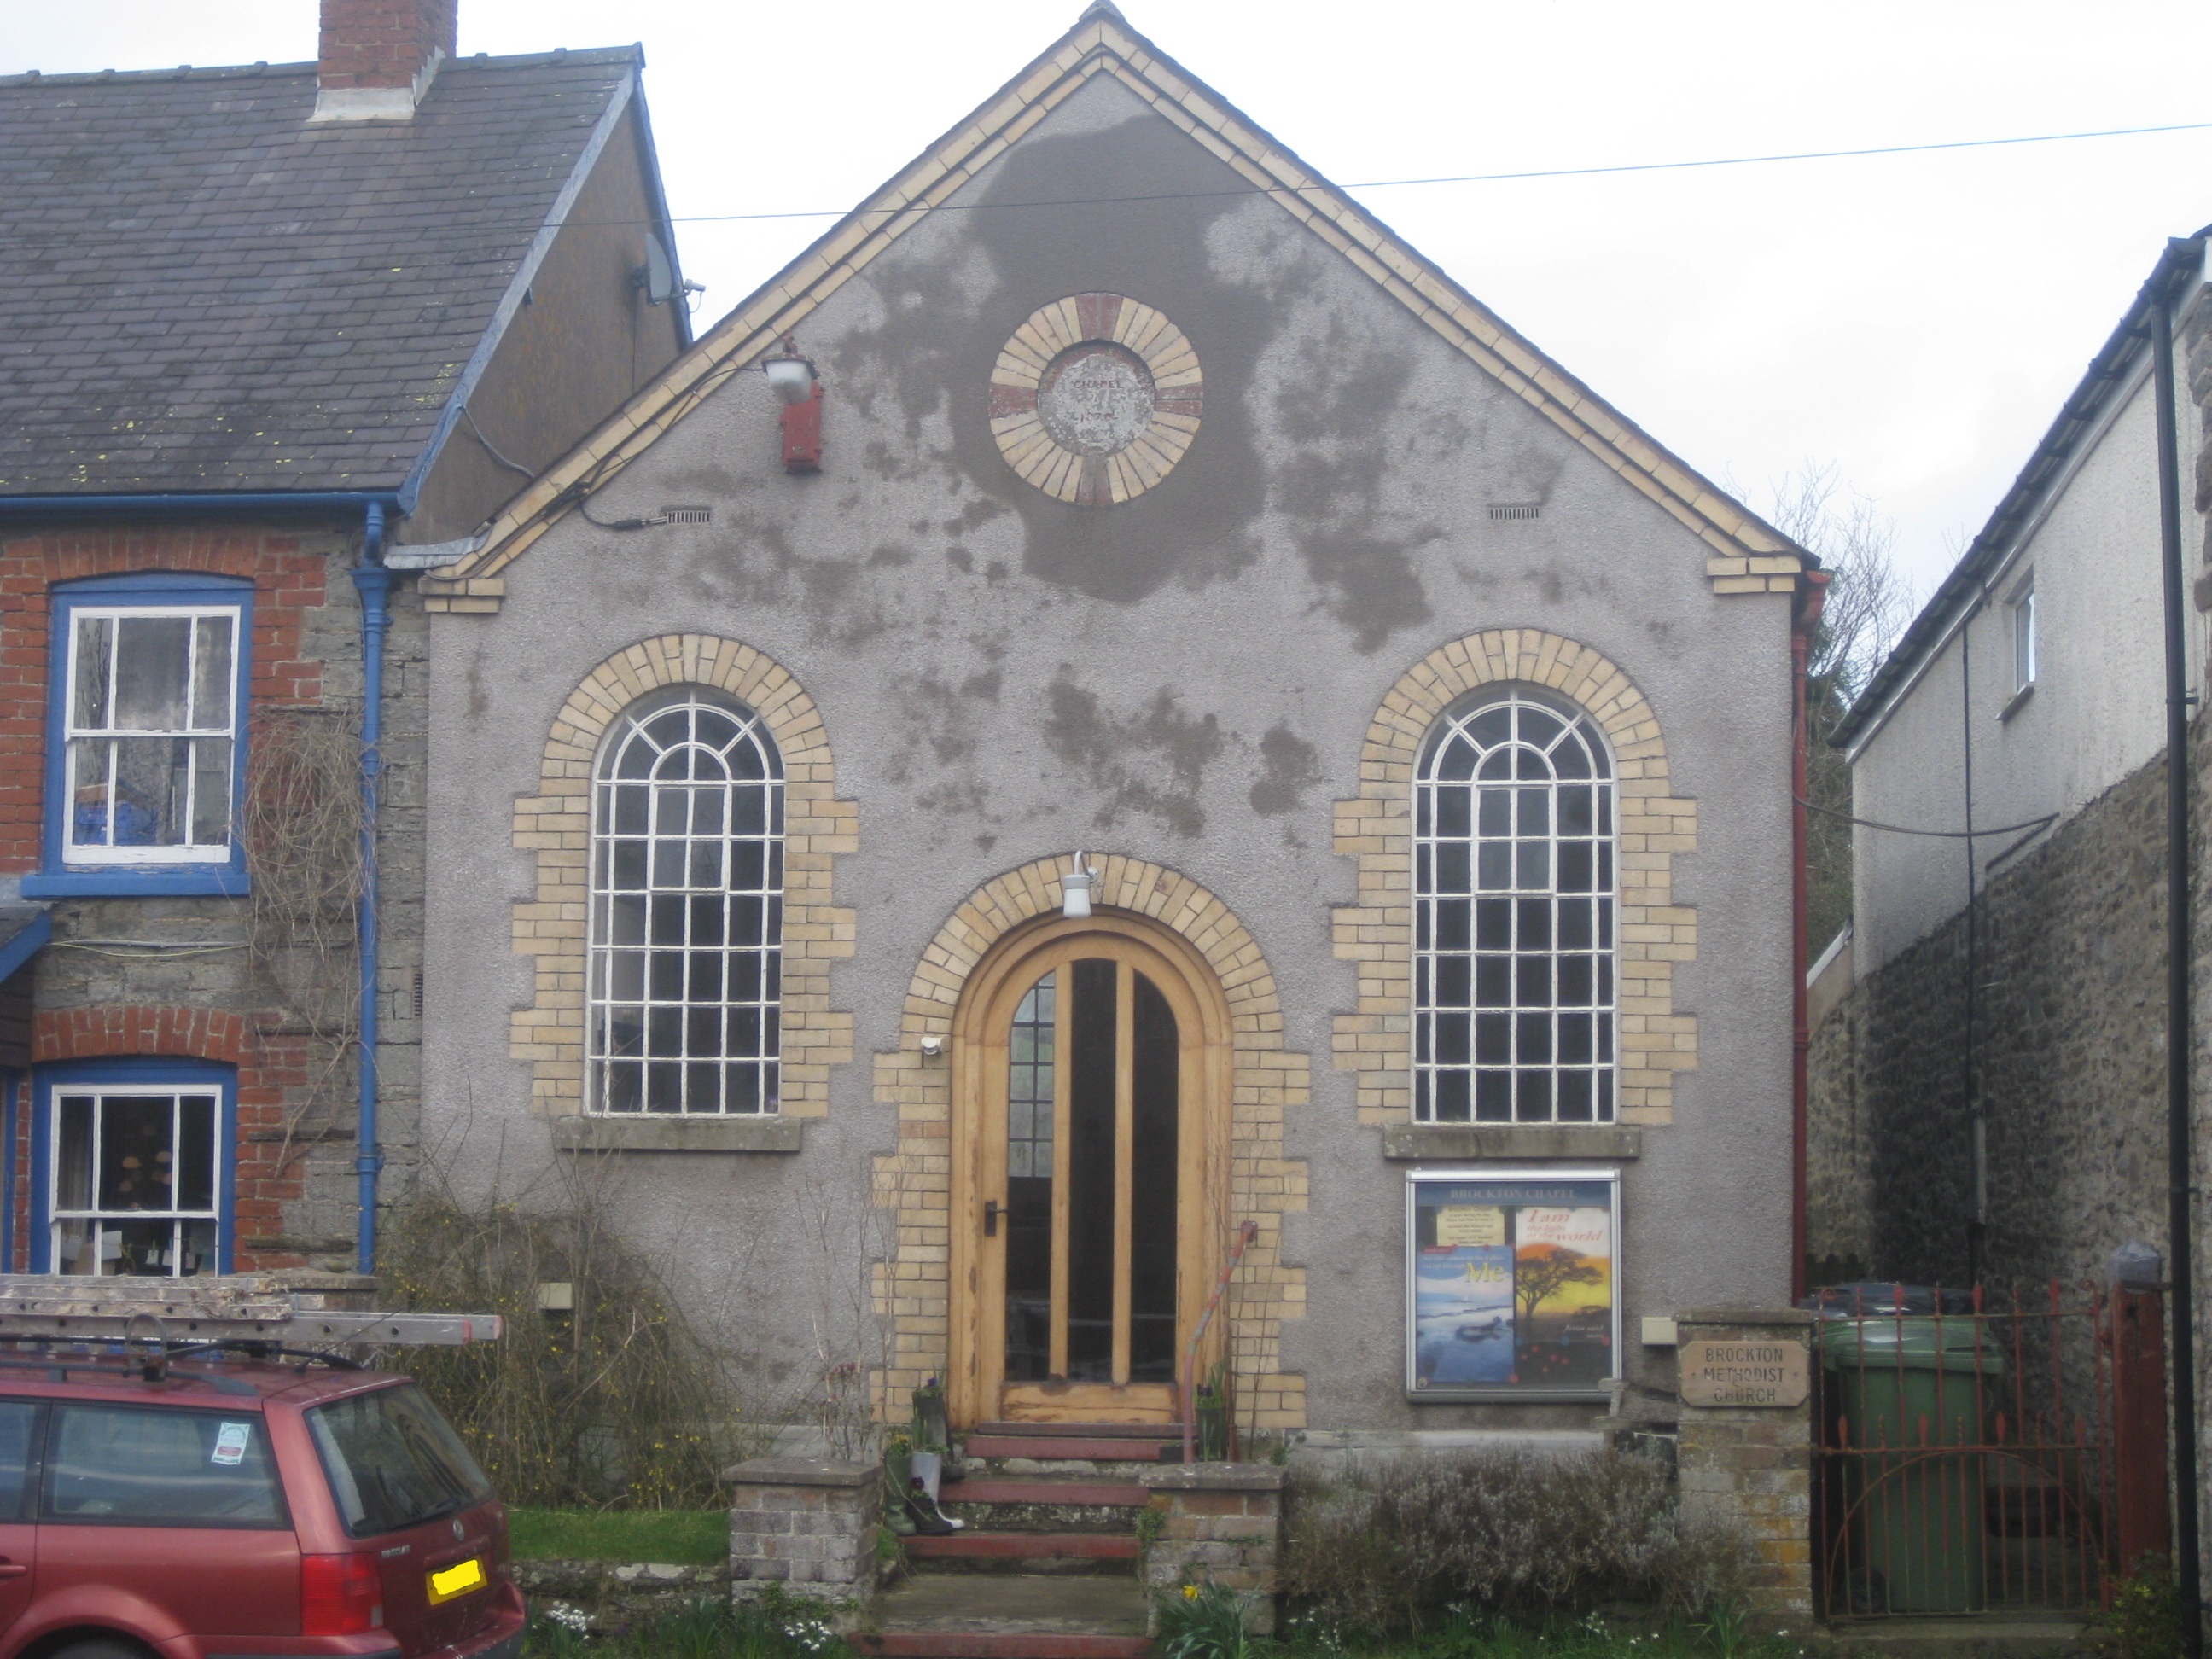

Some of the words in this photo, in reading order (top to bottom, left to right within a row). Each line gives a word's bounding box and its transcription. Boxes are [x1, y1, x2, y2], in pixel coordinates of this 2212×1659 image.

[1074, 379, 1123, 389] CHAPEL
[1451, 1189, 1522, 1199] BROCKTON
[1526, 1189, 1577, 1199] CHAPEL
[1528, 1209, 1540, 1222] I
[1540, 1213, 1569, 1223] am
[1557, 1231, 1604, 1241] world
[1466, 1262, 1505, 1283] Me
[1705, 1348, 1784, 1363] BROCKTON
[1703, 1367, 1785, 1382] METHODIST
[1714, 1388, 1776, 1402] CHURCH
